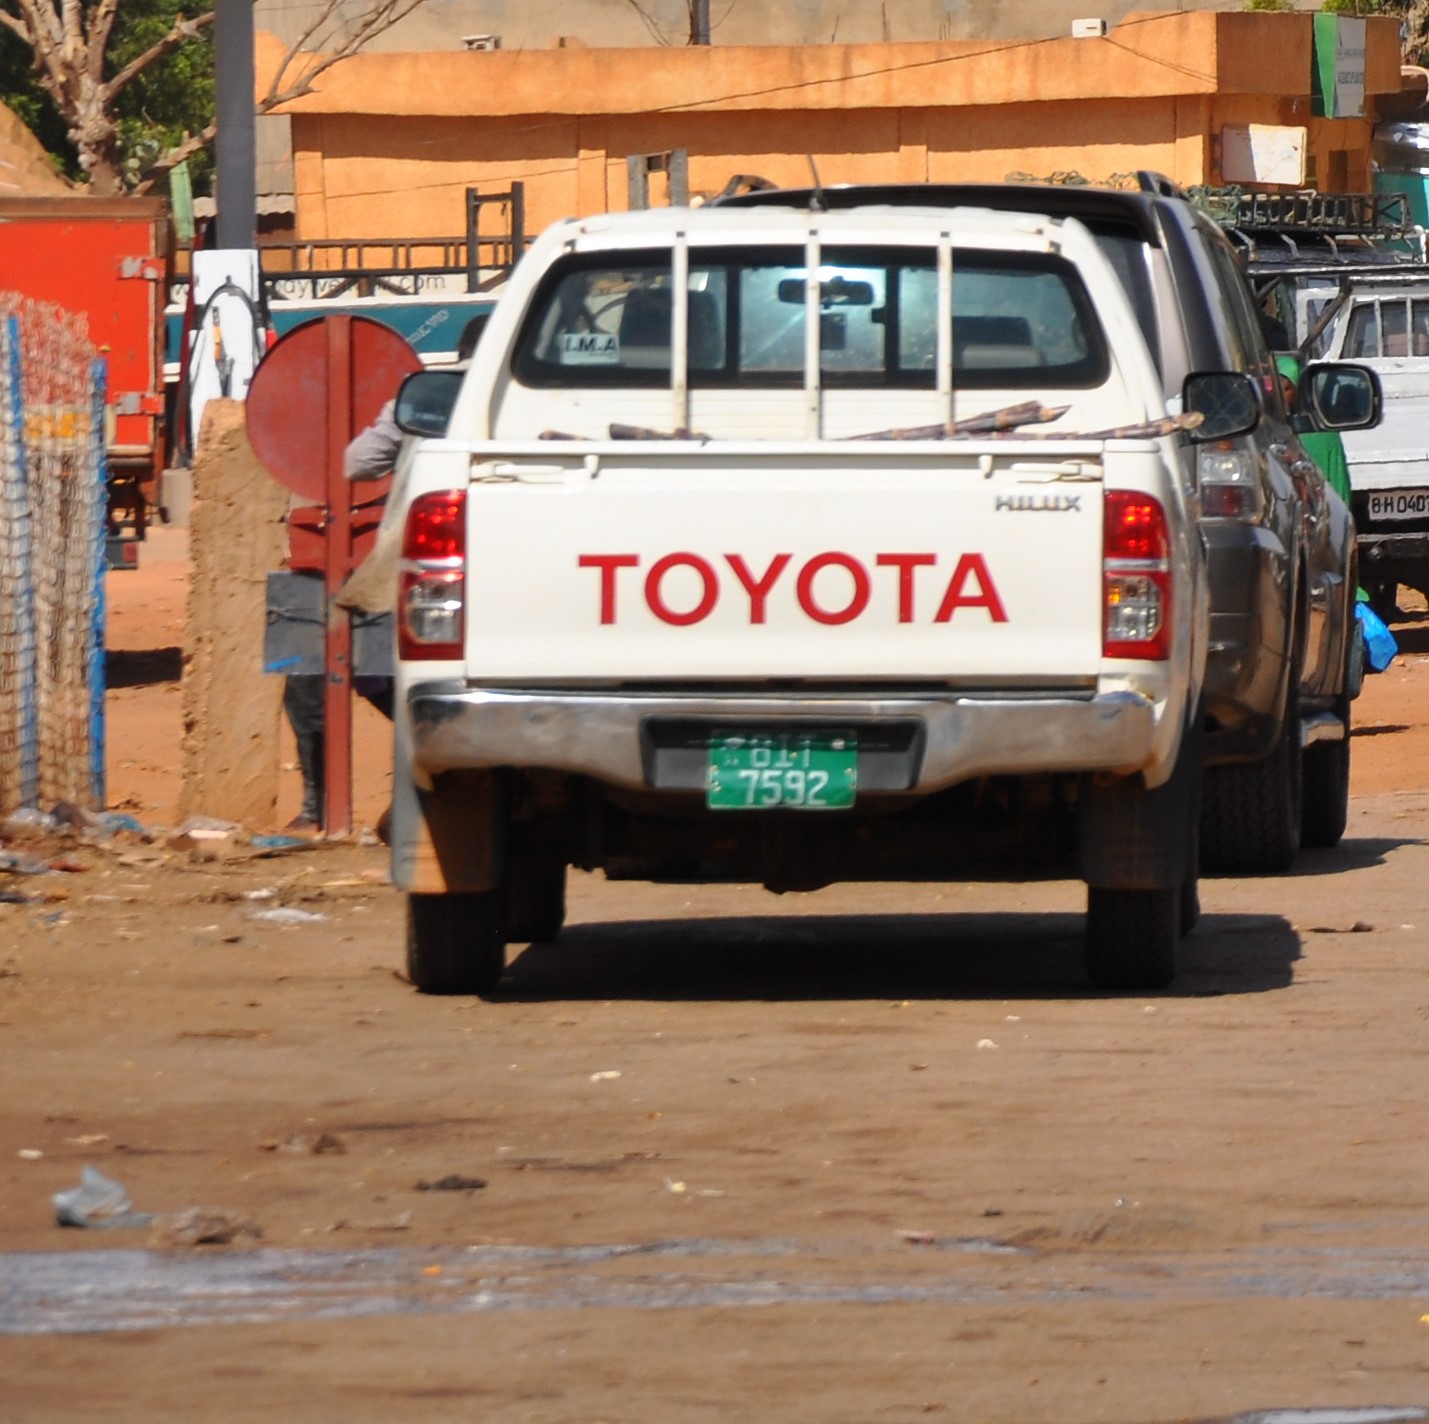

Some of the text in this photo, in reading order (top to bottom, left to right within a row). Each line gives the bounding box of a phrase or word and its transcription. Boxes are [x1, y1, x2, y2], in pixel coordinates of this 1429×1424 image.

[996, 495, 1080, 511] HILUX
[578, 551, 1009, 626] TOYOTA
[738, 769, 829, 805] 7592
